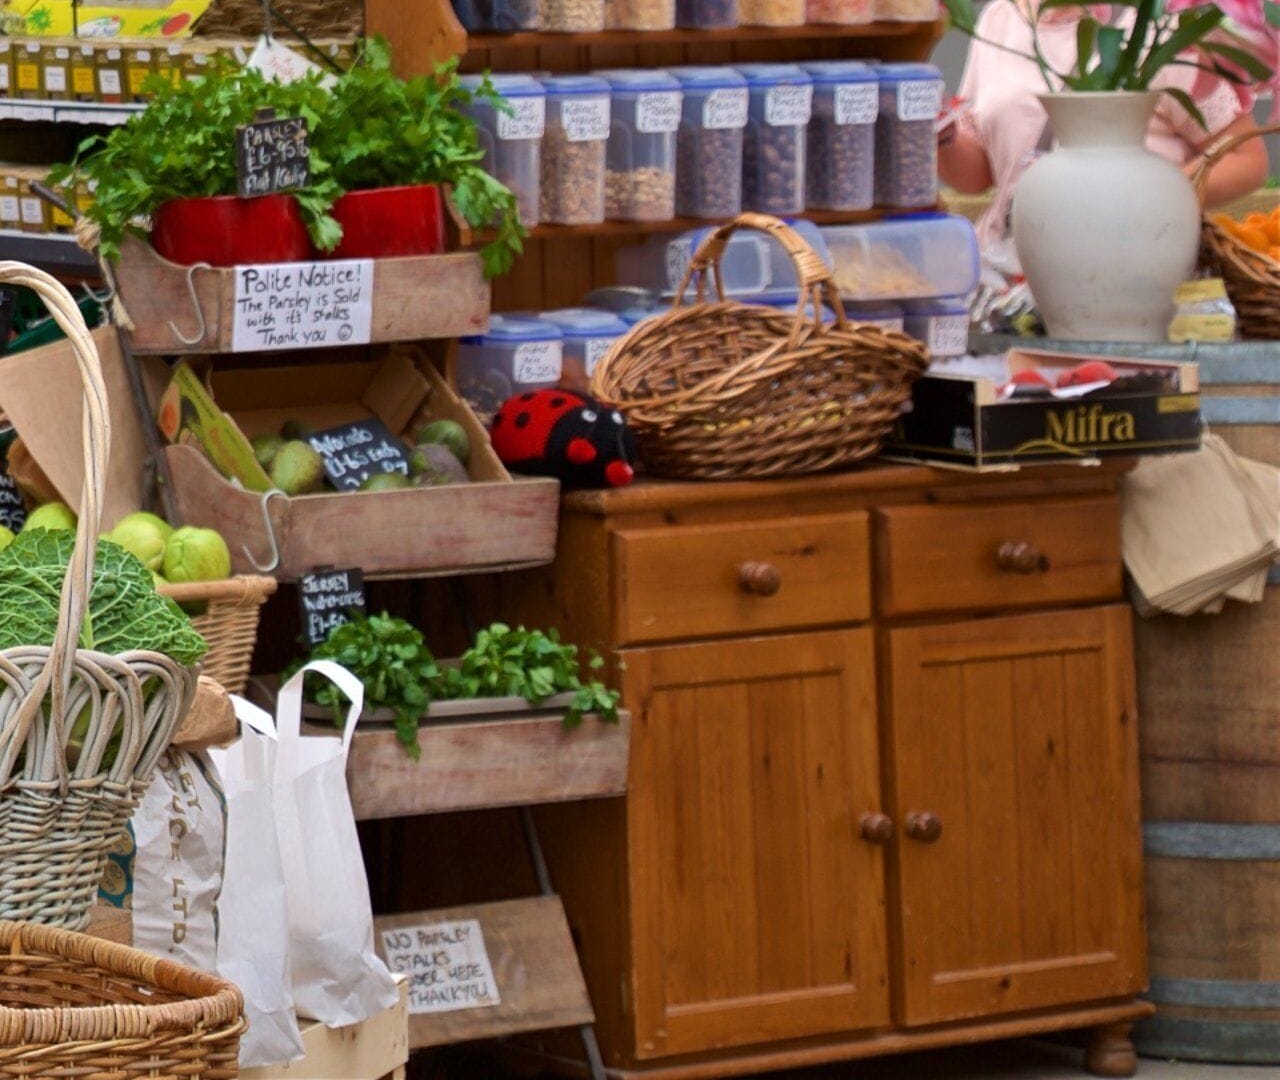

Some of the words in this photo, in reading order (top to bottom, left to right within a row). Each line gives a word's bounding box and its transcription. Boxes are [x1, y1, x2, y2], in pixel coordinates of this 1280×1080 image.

[242, 268, 292, 294] Polite
[299, 264, 362, 287] Notice!
[238, 297, 262, 312] The
[268, 291, 310, 313] Parsley
[317, 292, 328, 306] is
[334, 288, 361, 304] Sold
[246, 312, 276, 328] with
[286, 310, 302, 324] it's
[256, 327, 298, 346] Thank
[303, 330, 327, 344] you
[1044, 406, 1136, 444] Mifra
[303, 572, 349, 593] JERSEY
[168, 749, 204, 812] SEY
[386, 932, 412, 950] NO
[417, 926, 470, 948] PARSLEY
